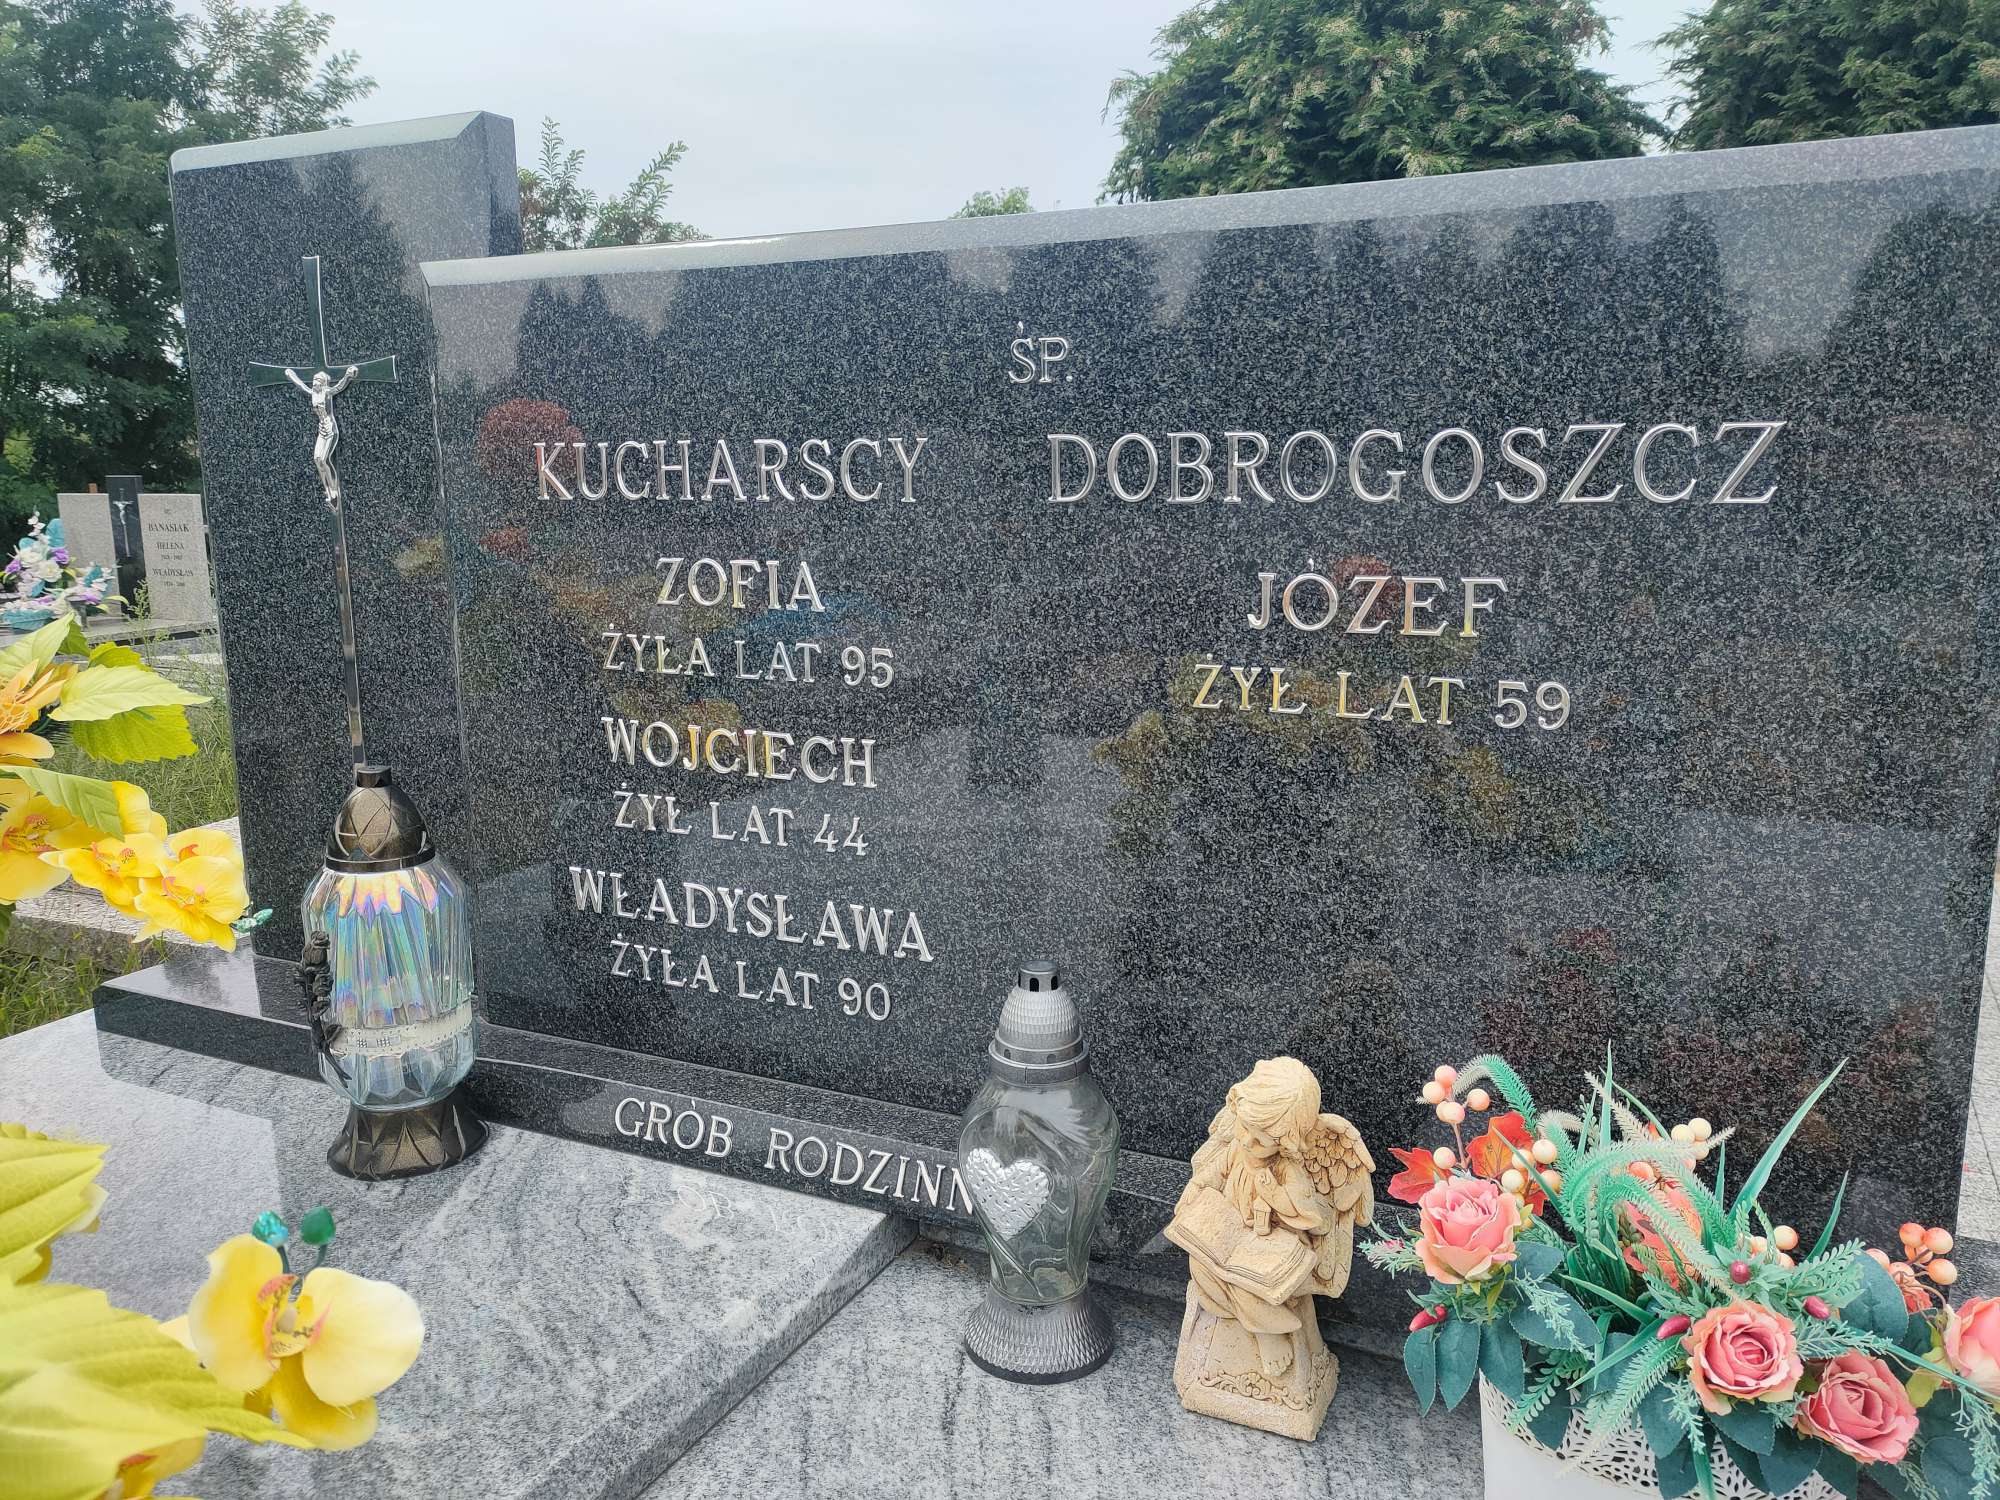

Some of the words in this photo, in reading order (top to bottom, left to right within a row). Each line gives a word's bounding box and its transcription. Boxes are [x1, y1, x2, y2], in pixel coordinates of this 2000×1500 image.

[533, 437, 929, 502] KUCHARSCY
[1047, 421, 1787, 504] DOBROGOSZCZ
[655, 557, 826, 613] ZOFIA
[1246, 558, 1509, 638] JÓZEF
[602, 622, 716, 678] ŻYŁA
[734, 641, 822, 684] LAT
[840, 645, 896, 689] 95
[1192, 653, 1308, 715] ŻYŁ
[1335, 670, 1465, 726] LAT
[1494, 680, 1571, 731] 59
[600, 715, 878, 789] WOJCIECH
[612, 782, 693, 836] ŻYŁ
[708, 801, 796, 847] LAT
[813, 813, 869, 857] 44
[568, 866, 934, 963] WŁADYSŁAWA
[610, 932, 720, 994] ŻYŁA
[735, 960, 821, 1010] LAT
[837, 977, 892, 1022] 90
[763, 1127, 974, 1215] RODZINN
